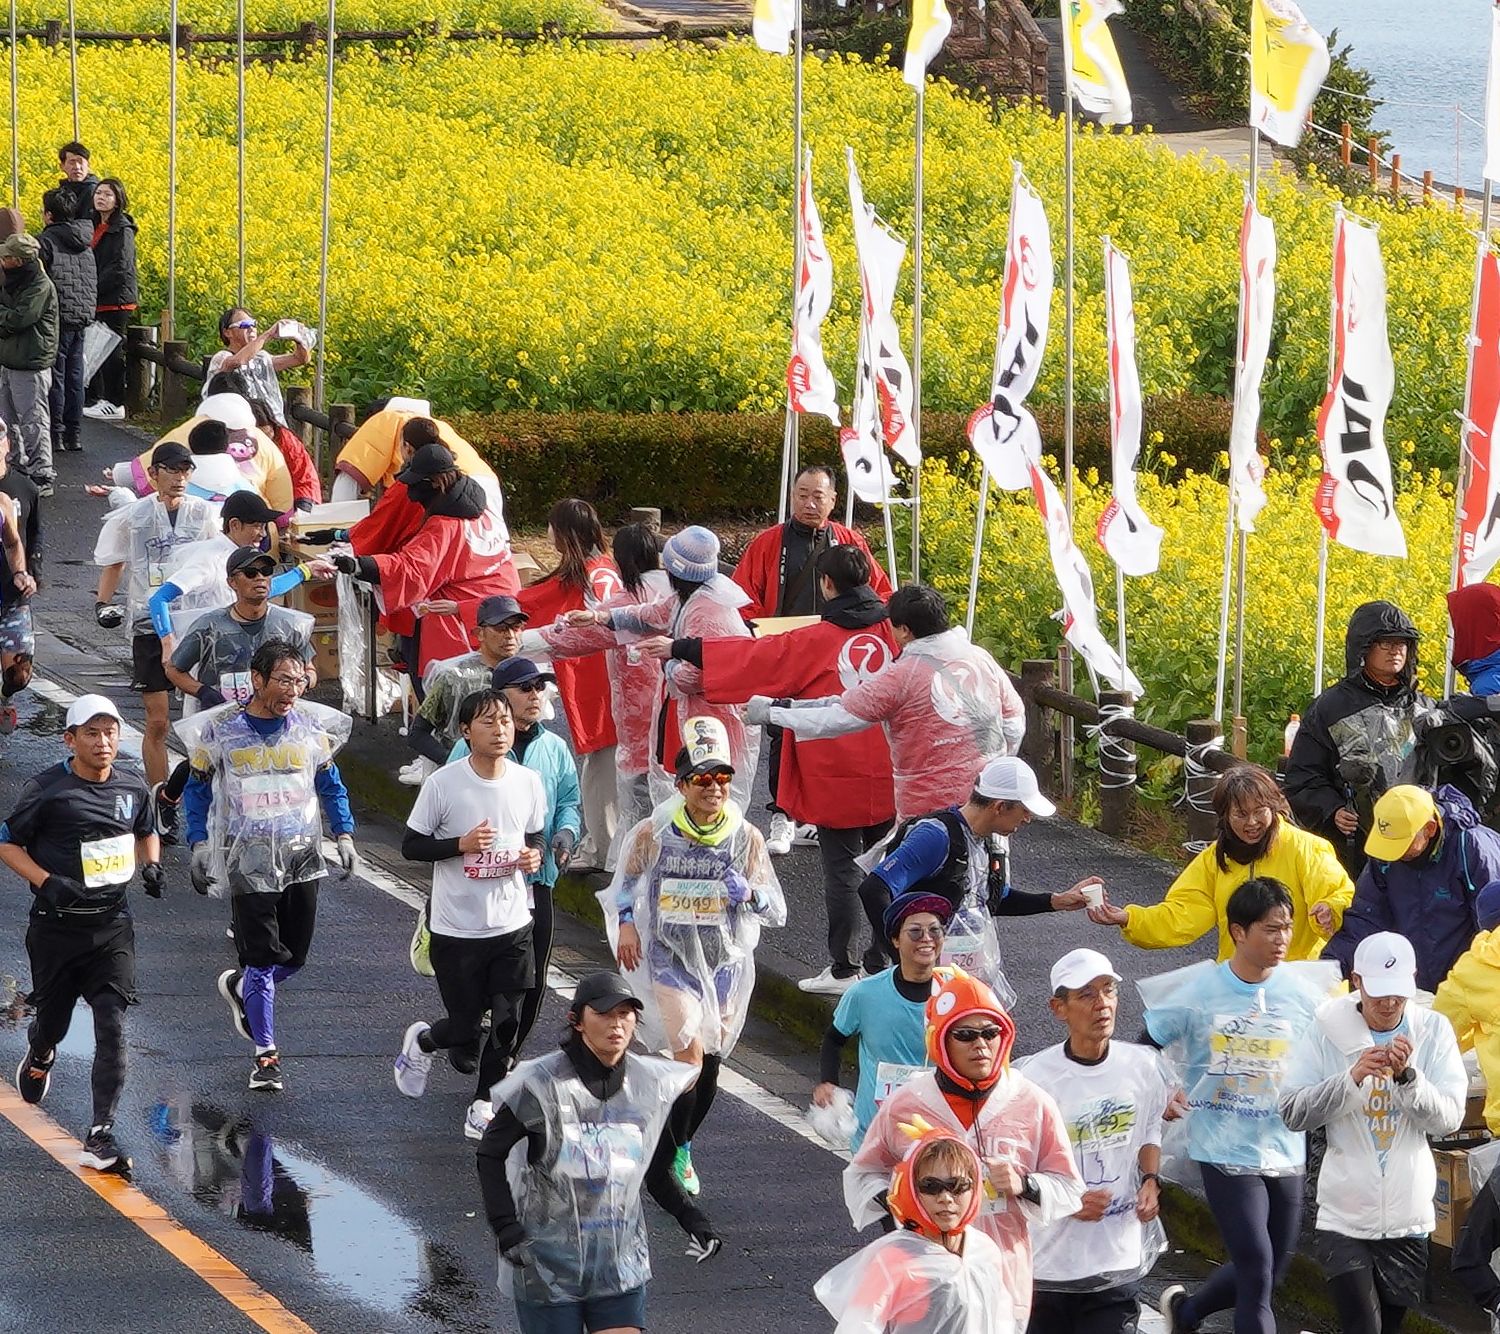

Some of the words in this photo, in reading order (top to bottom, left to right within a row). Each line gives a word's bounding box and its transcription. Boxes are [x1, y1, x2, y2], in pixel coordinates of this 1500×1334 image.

[1339, 372, 1390, 520] JAC
[475, 850, 510, 865] 2164
[669, 895, 712, 910] 5049
